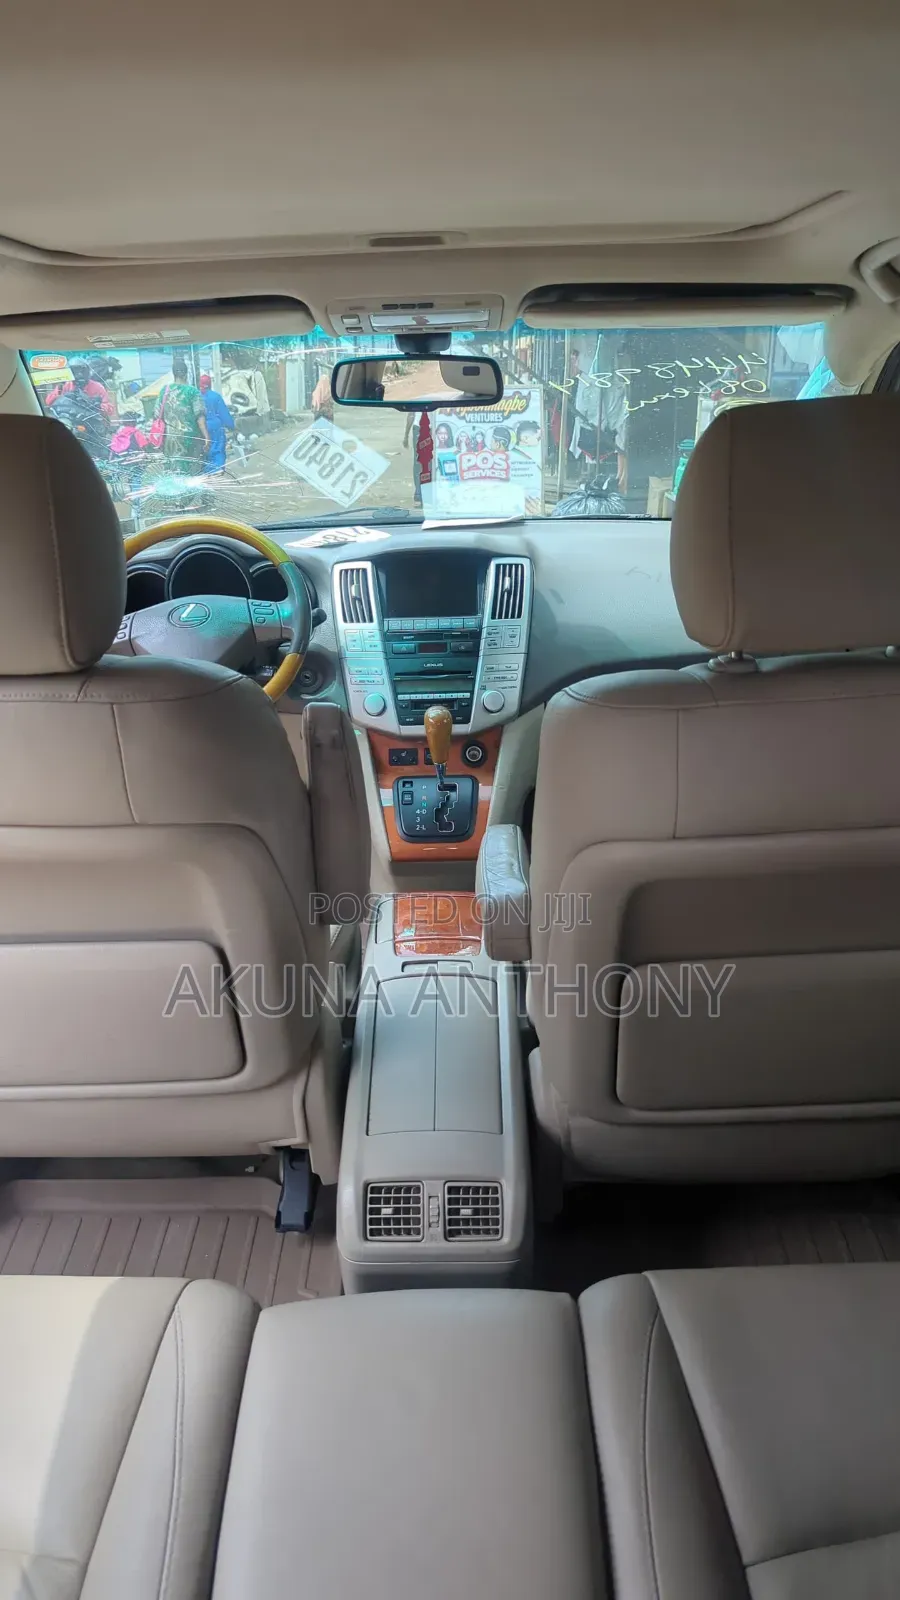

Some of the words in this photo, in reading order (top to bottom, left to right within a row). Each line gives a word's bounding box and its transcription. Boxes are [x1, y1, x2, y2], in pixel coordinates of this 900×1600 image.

[465, 412, 503, 422] VENTURES
[462, 452, 508, 470] POS
[463, 470, 507, 479] SERVICES
